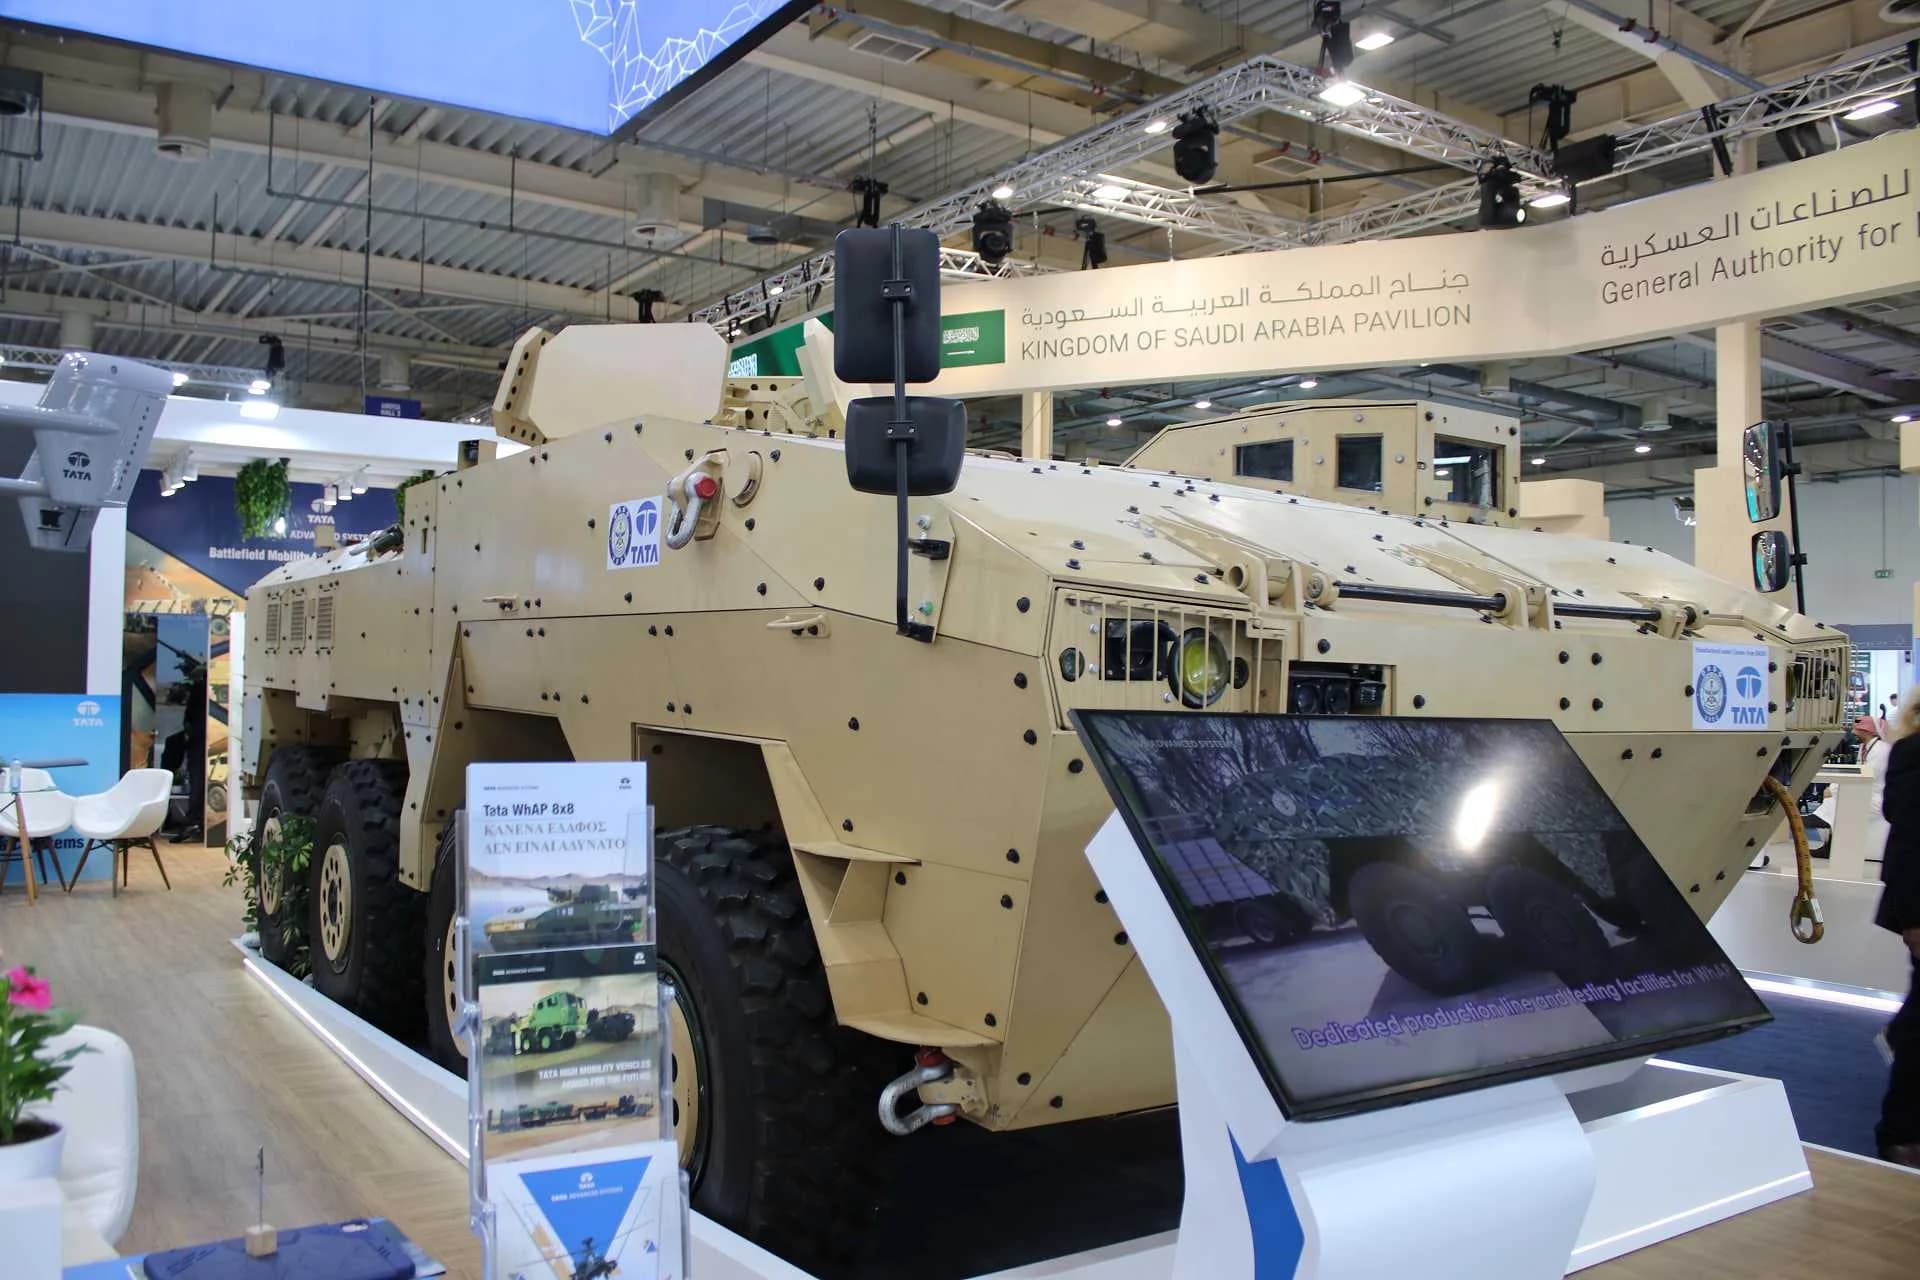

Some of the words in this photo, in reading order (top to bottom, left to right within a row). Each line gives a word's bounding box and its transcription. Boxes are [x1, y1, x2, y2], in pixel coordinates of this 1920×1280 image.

[1602, 261, 1700, 305] General
[1711, 233, 1844, 283] Authority
[1857, 221, 1902, 251] for
[1021, 332, 1129, 361] KINGDOM
[1137, 329, 1168, 351] OF
[1174, 322, 1245, 348] SAUDI
[1254, 314, 1346, 342] ARABIA
[1353, 303, 1471, 333] PAVILION
[63, 469, 92, 481] TATA
[306, 514, 335, 524] TATA
[289, 529, 342, 542] ADVAD
[209, 546, 267, 560] Battlefield
[630, 543, 659, 565] TATA
[73, 717, 103, 727] TATA
[1730, 706, 1766, 725] TATA
[483, 804, 509, 817] Tata
[512, 802, 548, 816] WhAP
[551, 802, 575, 815] 8x8
[1292, 1013, 1402, 1049] Dedicated
[1403, 1000, 1499, 1037] production
